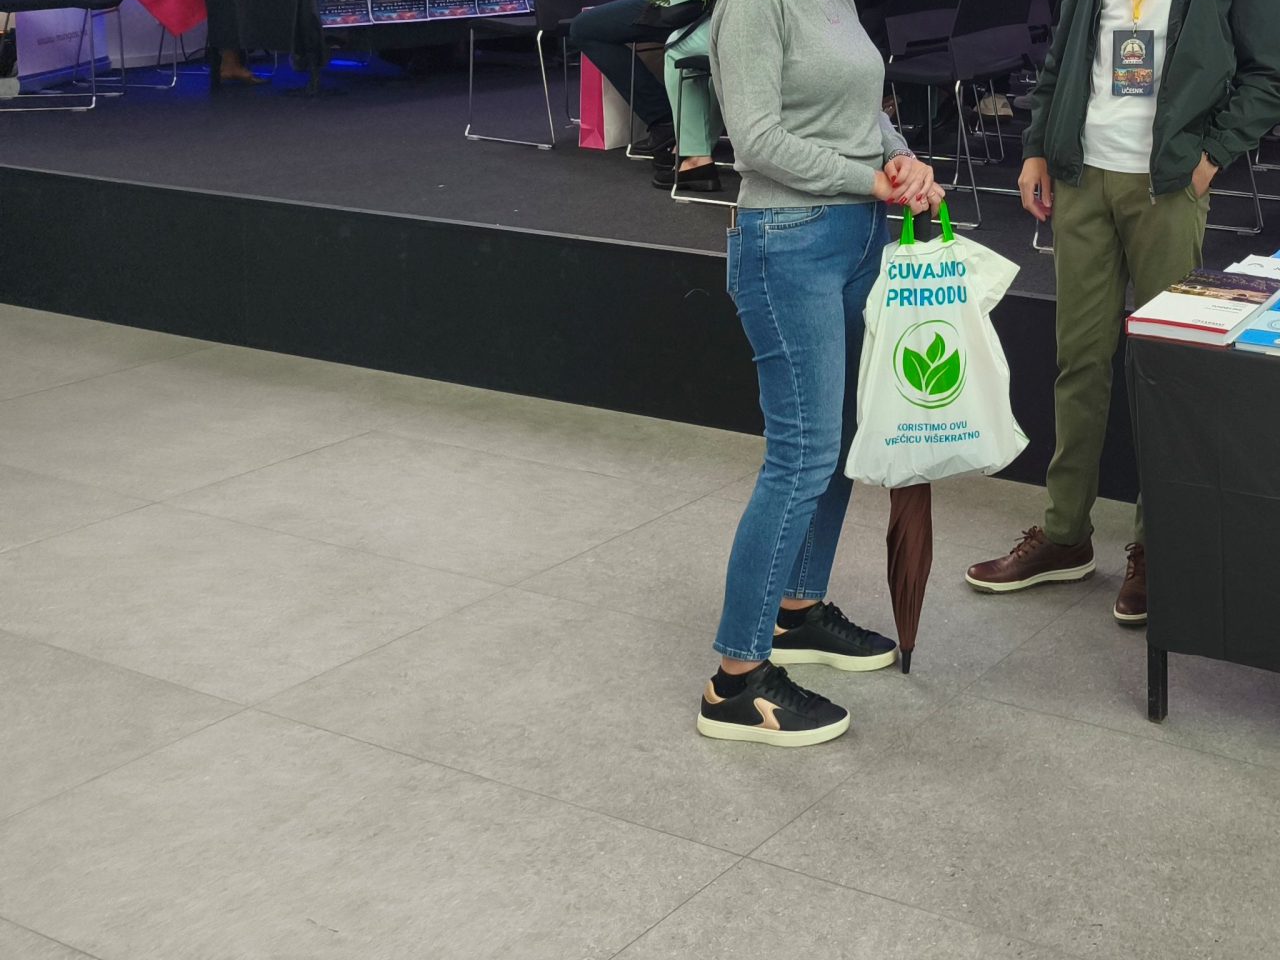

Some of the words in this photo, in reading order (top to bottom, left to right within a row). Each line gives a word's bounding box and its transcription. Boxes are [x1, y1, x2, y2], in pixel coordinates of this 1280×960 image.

[887, 260, 967, 280] ČUVAJMO
[886, 285, 968, 307] PRIRODU
[896, 422, 948, 432] KORISTIMO
[949, 420, 968, 431] OVU
[924, 431, 980, 444] VIŠEKRATNO
